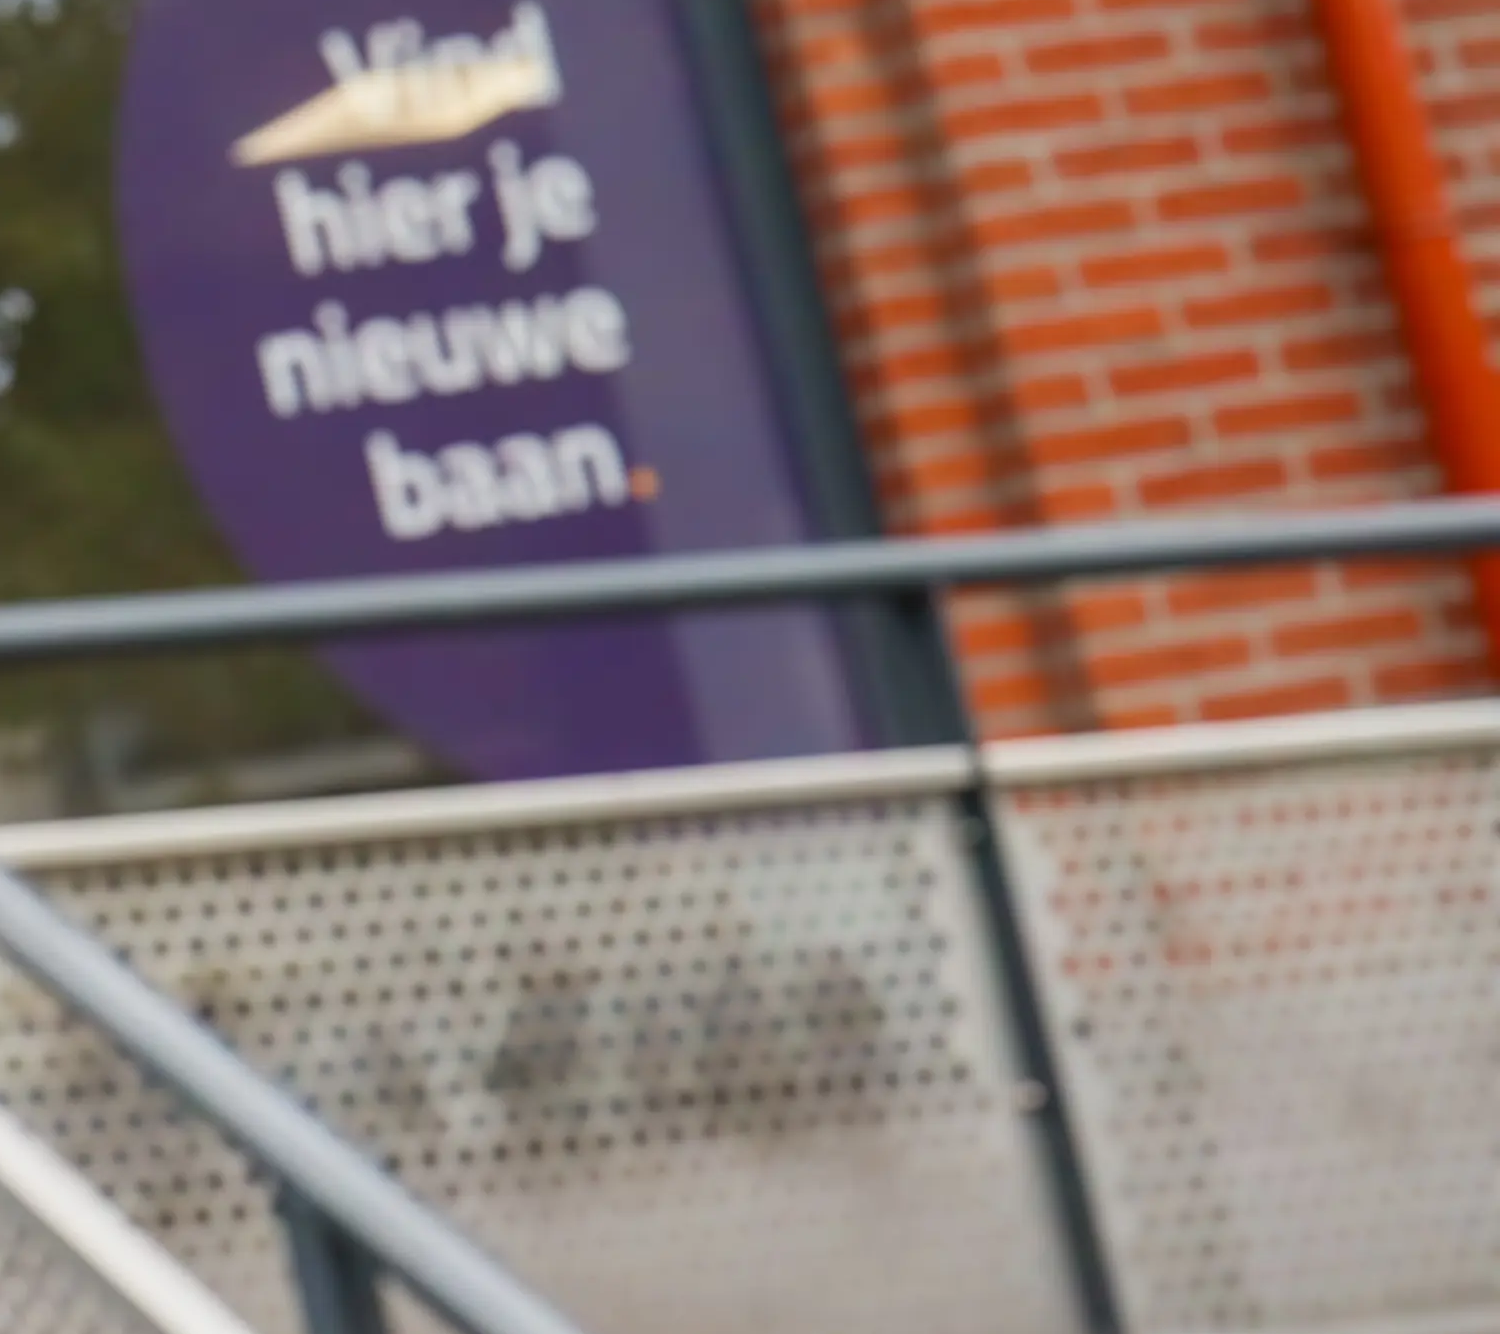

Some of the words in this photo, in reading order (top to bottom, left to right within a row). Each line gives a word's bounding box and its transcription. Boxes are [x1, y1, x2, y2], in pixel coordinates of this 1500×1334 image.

[274, 162, 479, 275] hier
[488, 139, 597, 270] je
[257, 287, 631, 417] nieuwe
[364, 422, 660, 540] baan.
